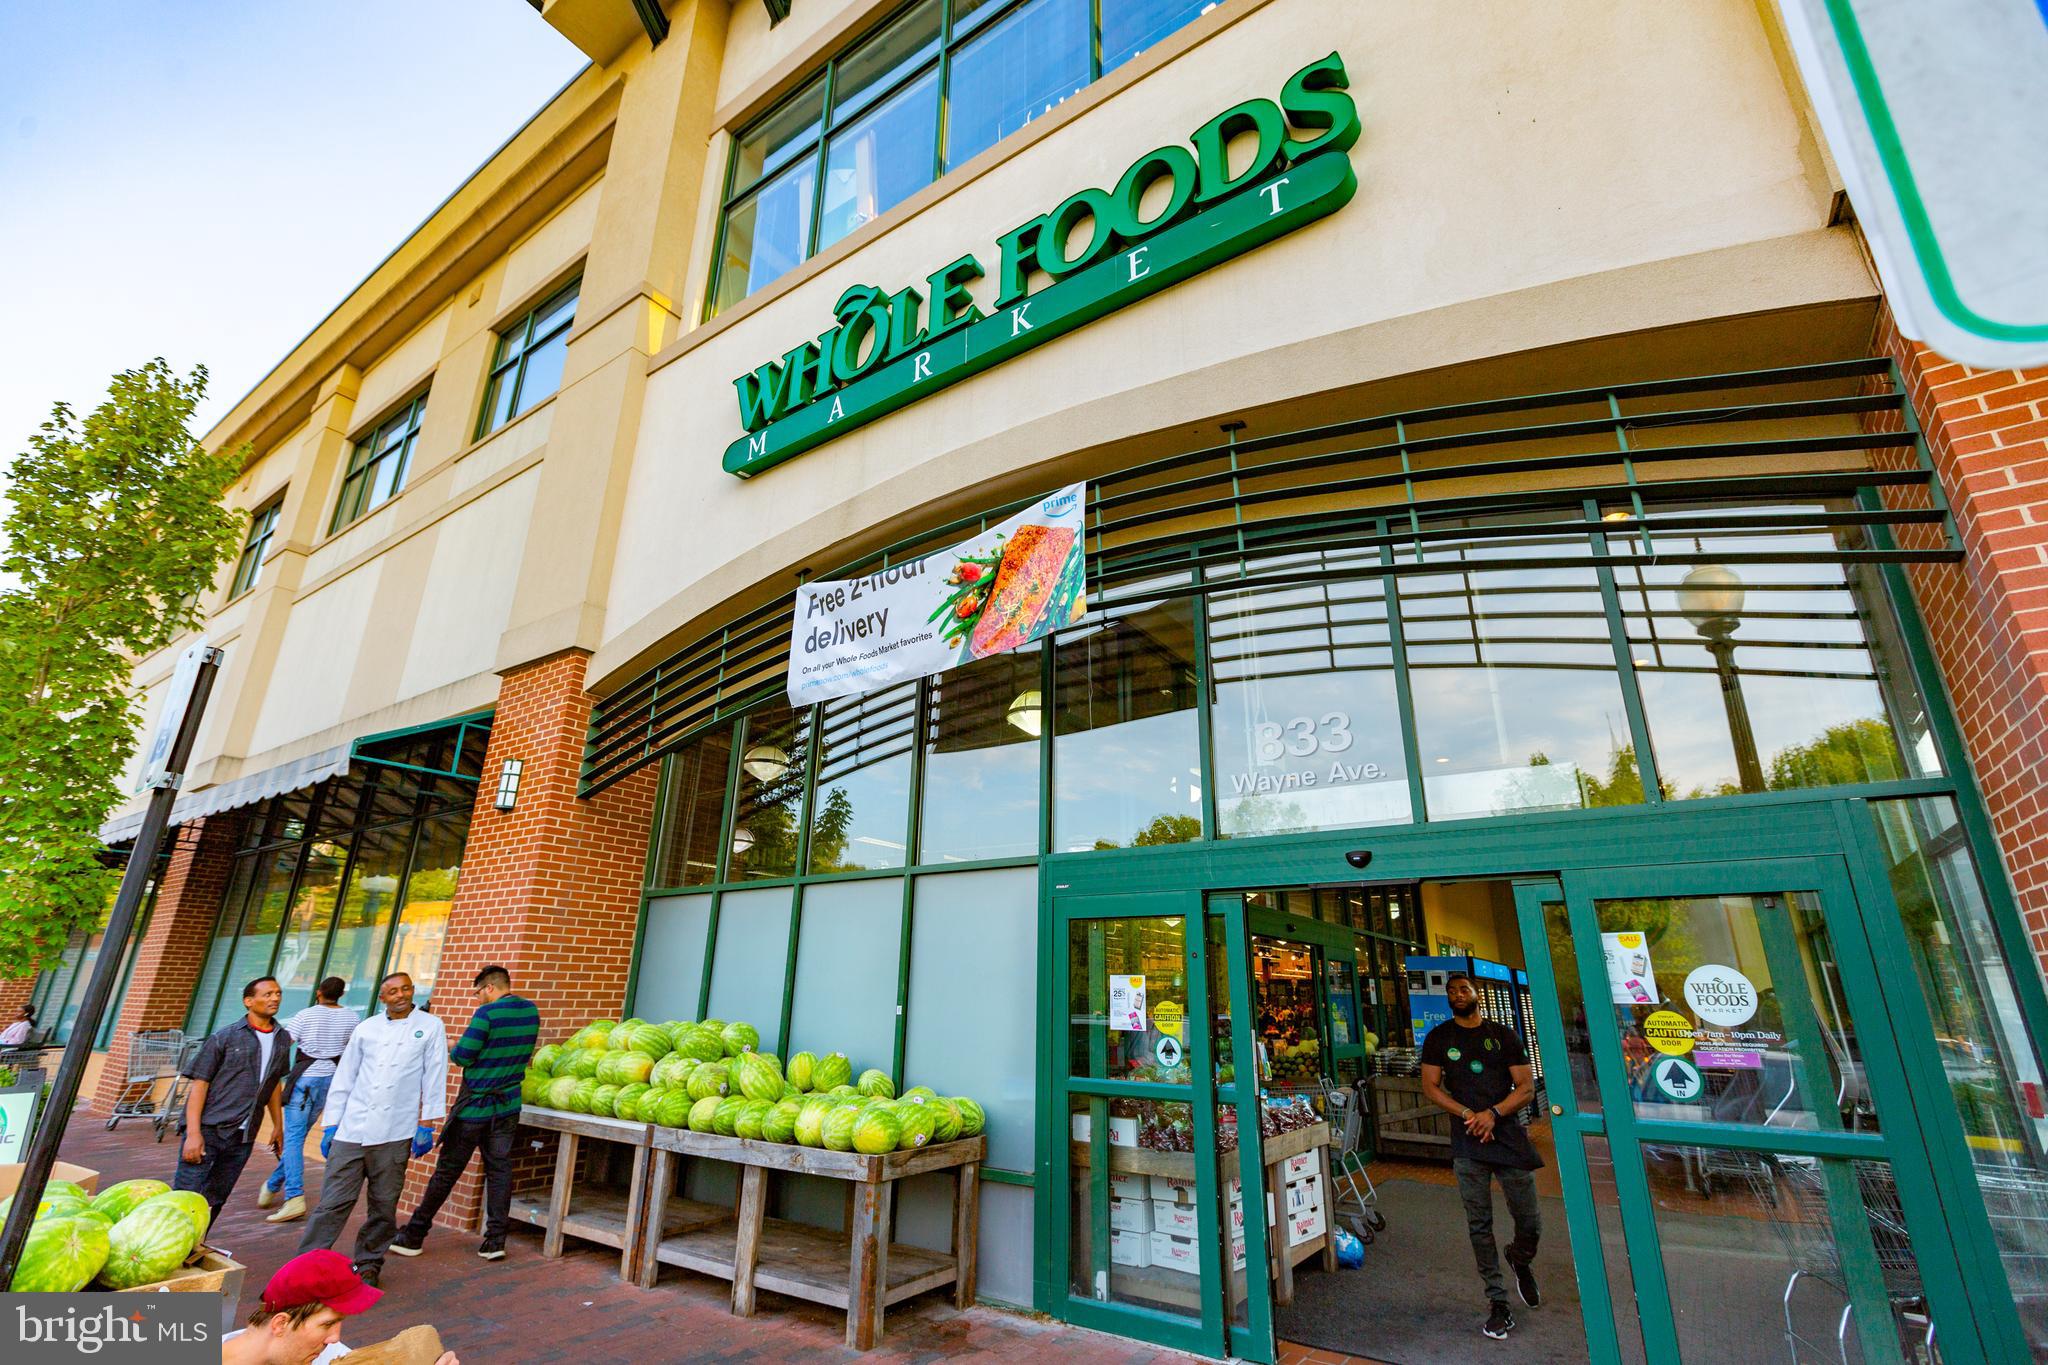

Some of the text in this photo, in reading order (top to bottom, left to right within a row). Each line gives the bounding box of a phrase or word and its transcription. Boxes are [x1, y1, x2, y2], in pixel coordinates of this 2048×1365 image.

[733, 51, 1361, 432] WHOLE FOODS
[746, 178, 1289, 461] MARKET
[1043, 494, 1077, 512] prime
[807, 560, 926, 619] Free 2-hour
[804, 607, 889, 654] delivery
[802, 632, 933, 675] On all your Whole Foods Market favorites
[1255, 712, 1353, 761] 833
[1231, 761, 1387, 794] Wayne Ave.
[1690, 982, 1748, 994] WHOLE
[1696, 995, 1749, 1007] FOODS
[1423, 1011, 1446, 1020] Free
[1680, 1029, 1704, 1039] Open
[1757, 1031, 1782, 1041] Daily
